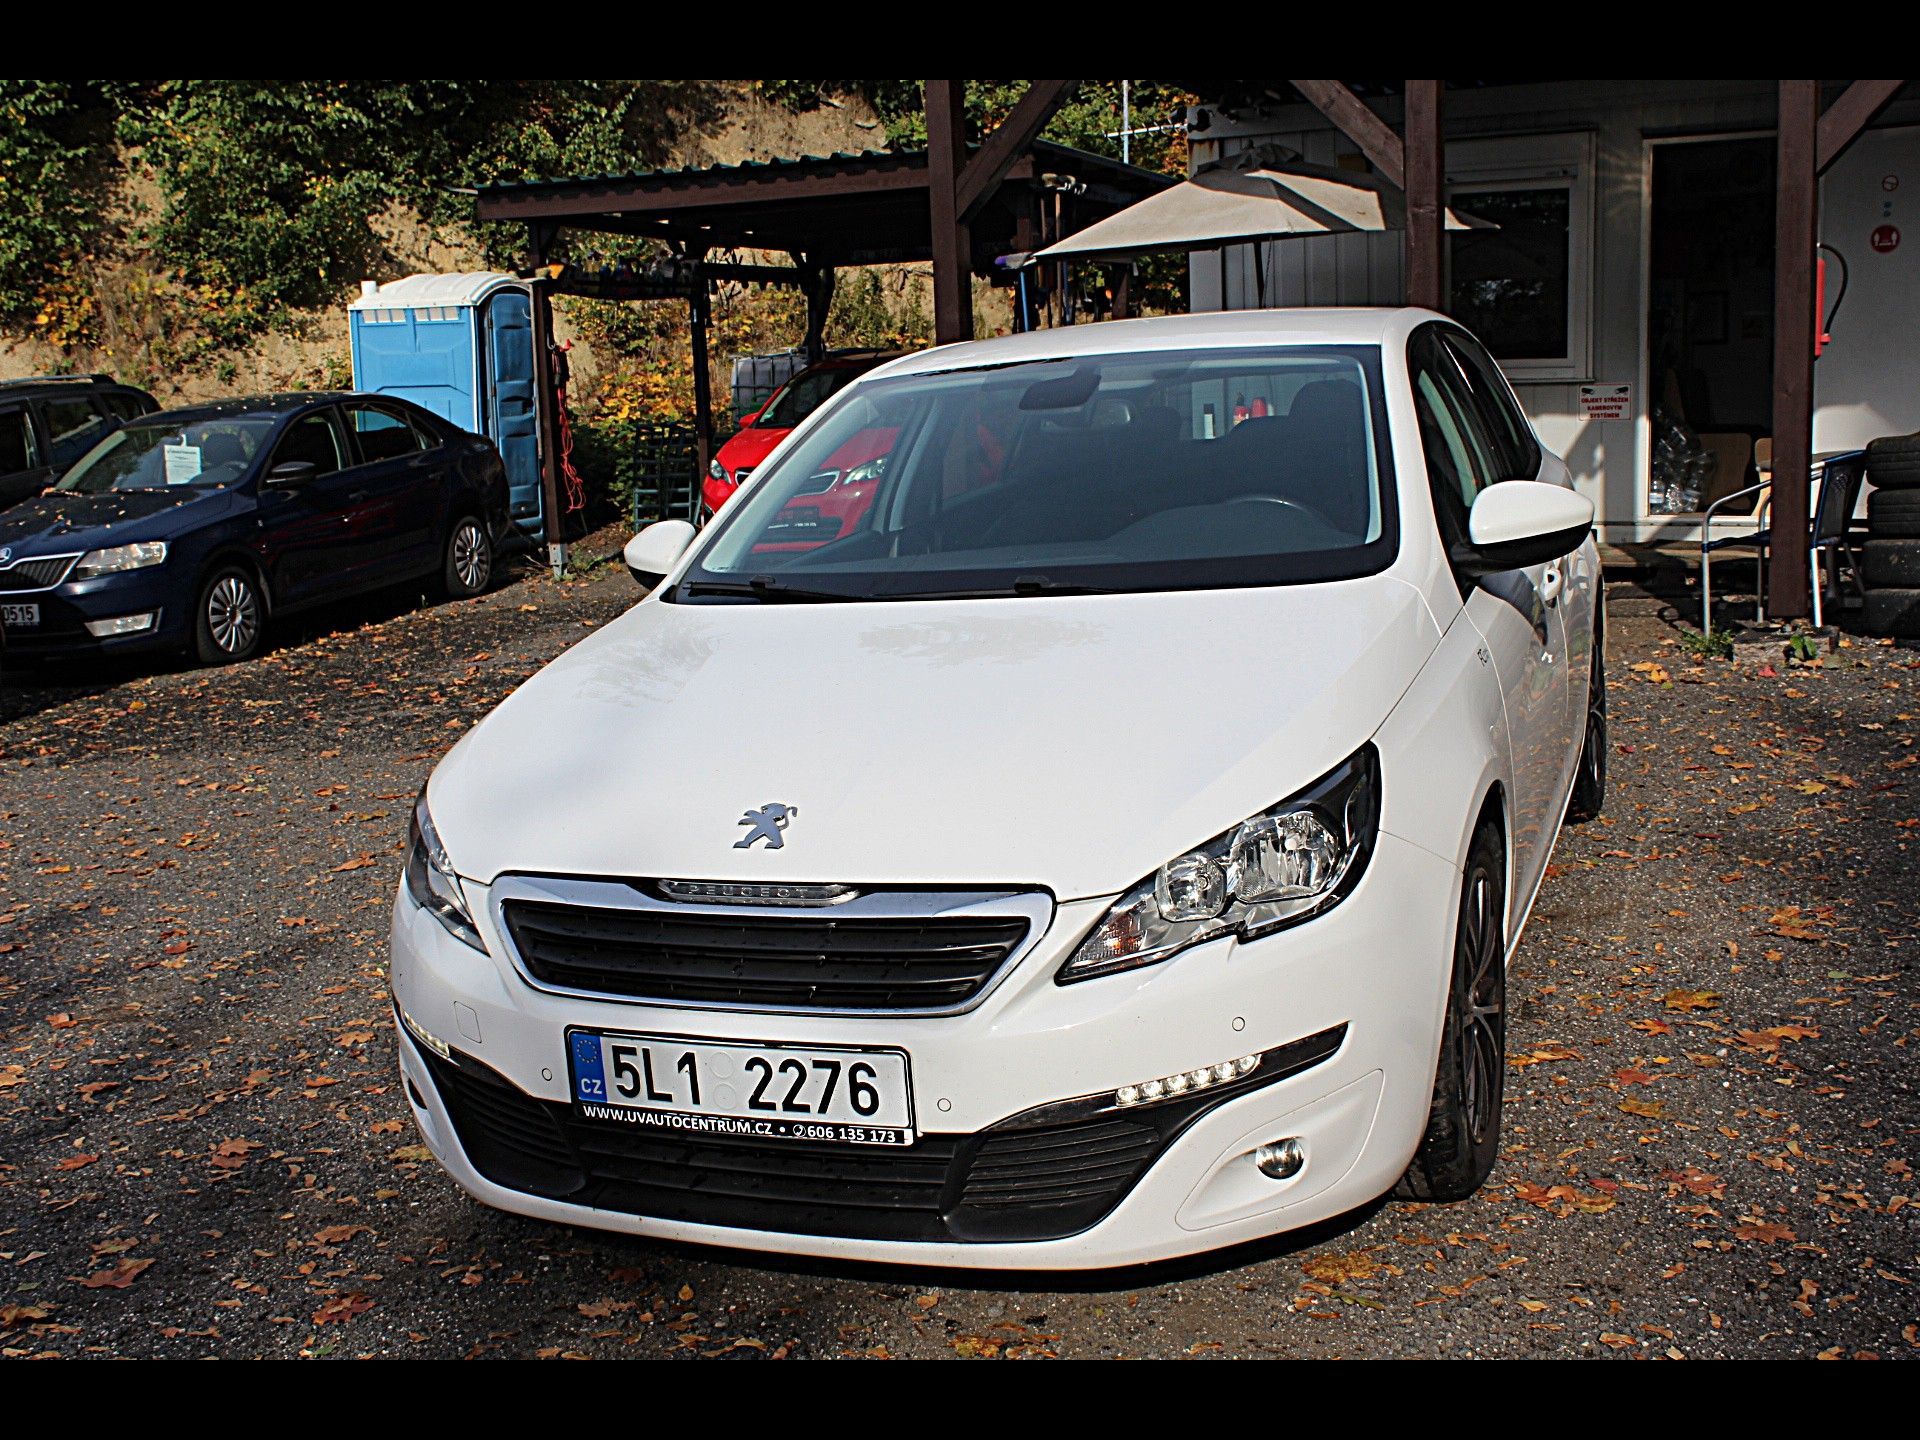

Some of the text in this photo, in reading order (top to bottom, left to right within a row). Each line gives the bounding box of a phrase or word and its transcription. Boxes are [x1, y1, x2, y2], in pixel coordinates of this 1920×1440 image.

[580, 1078, 603, 1095] CZ
[611, 1044, 880, 1117] 5L1 2276
[582, 1105, 896, 1143] WWW.UVAUTOCENTRUM.CZ 606 135 173
